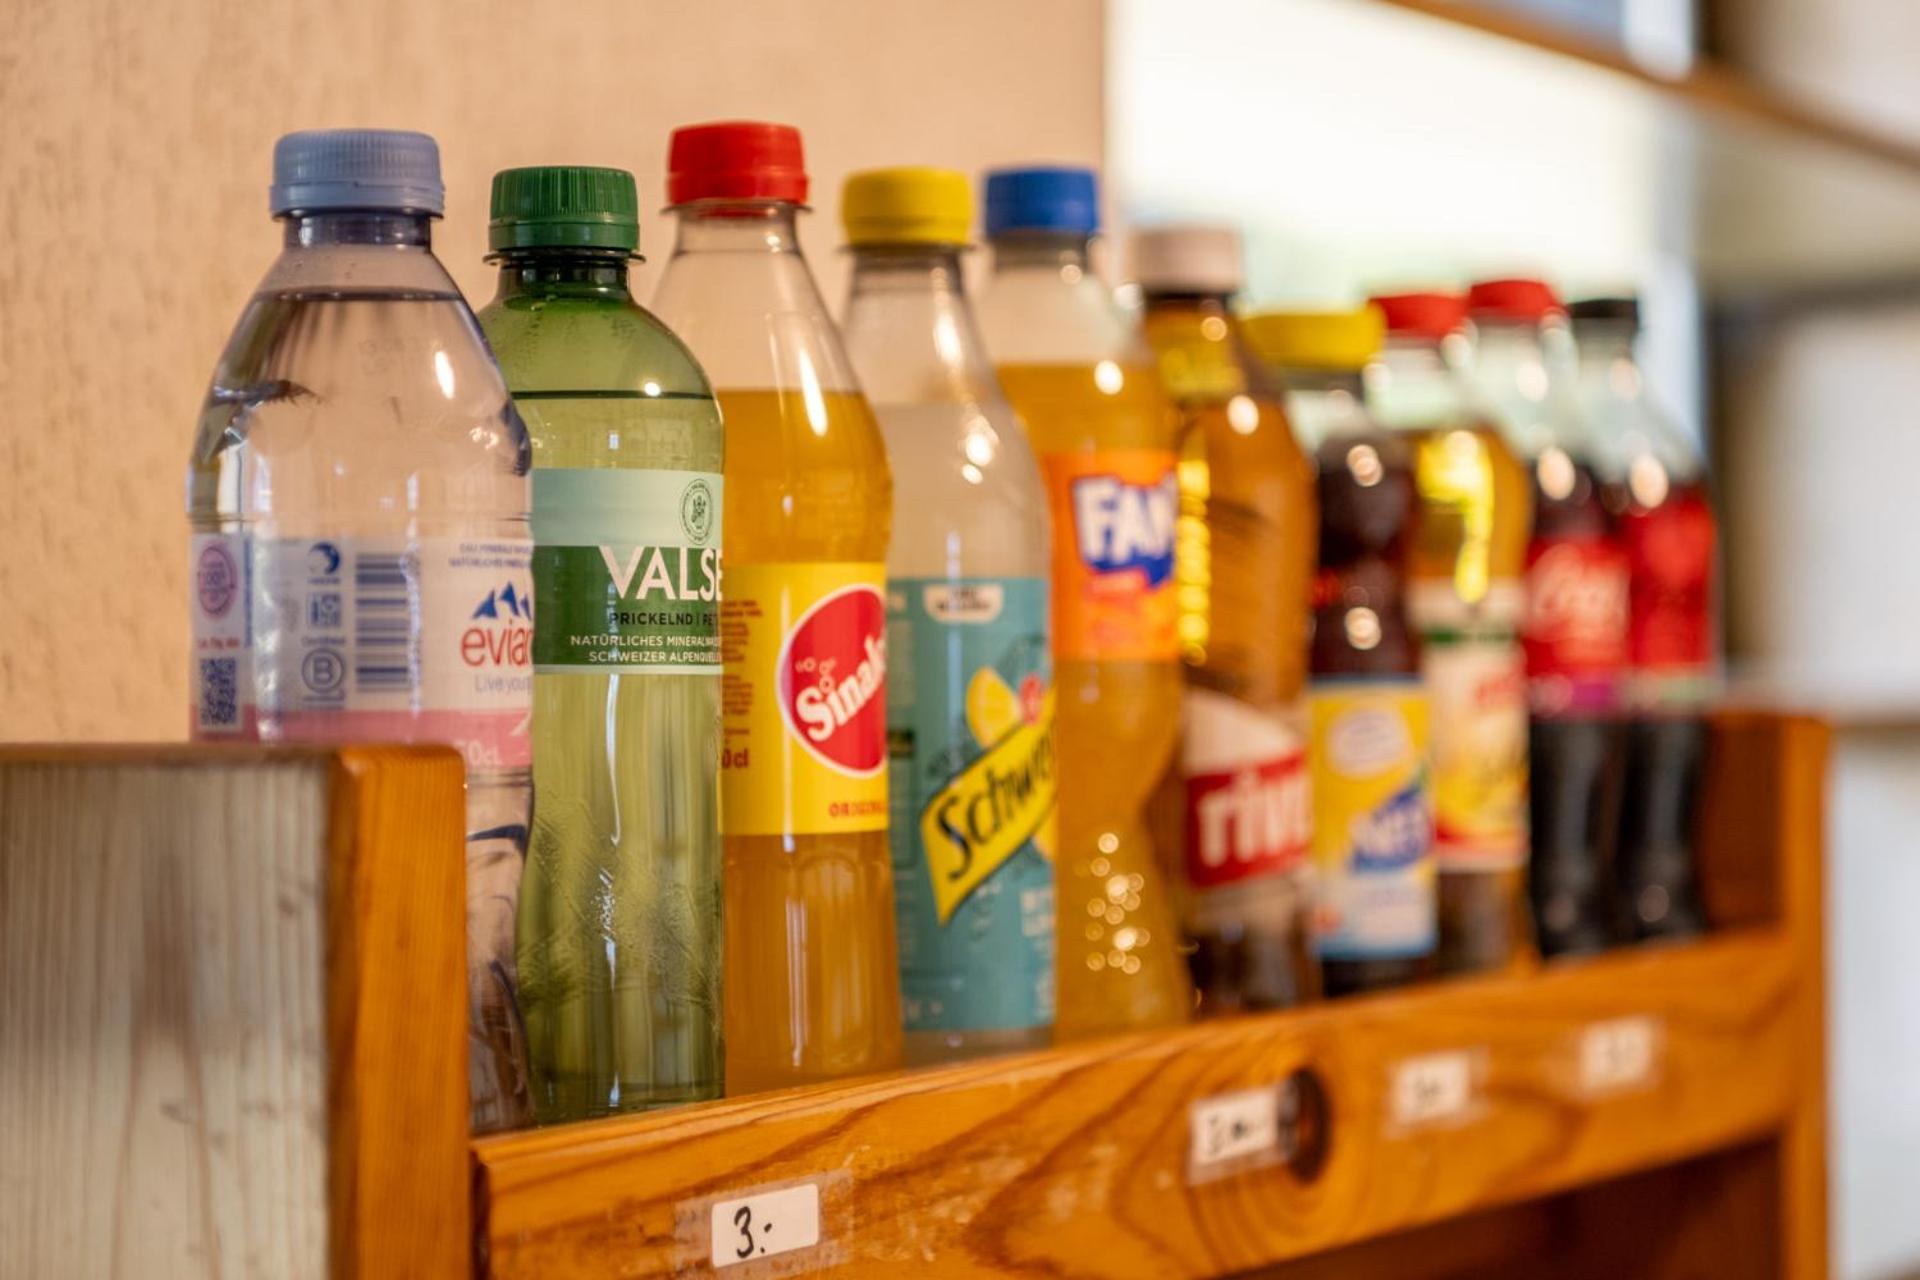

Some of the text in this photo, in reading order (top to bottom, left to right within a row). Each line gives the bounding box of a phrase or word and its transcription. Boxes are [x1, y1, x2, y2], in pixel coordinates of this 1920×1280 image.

[609, 612, 692, 625] PRICKELND
[570, 634, 663, 647] NATÜRLICHES
[589, 651, 666, 663] SCHWEIZER
